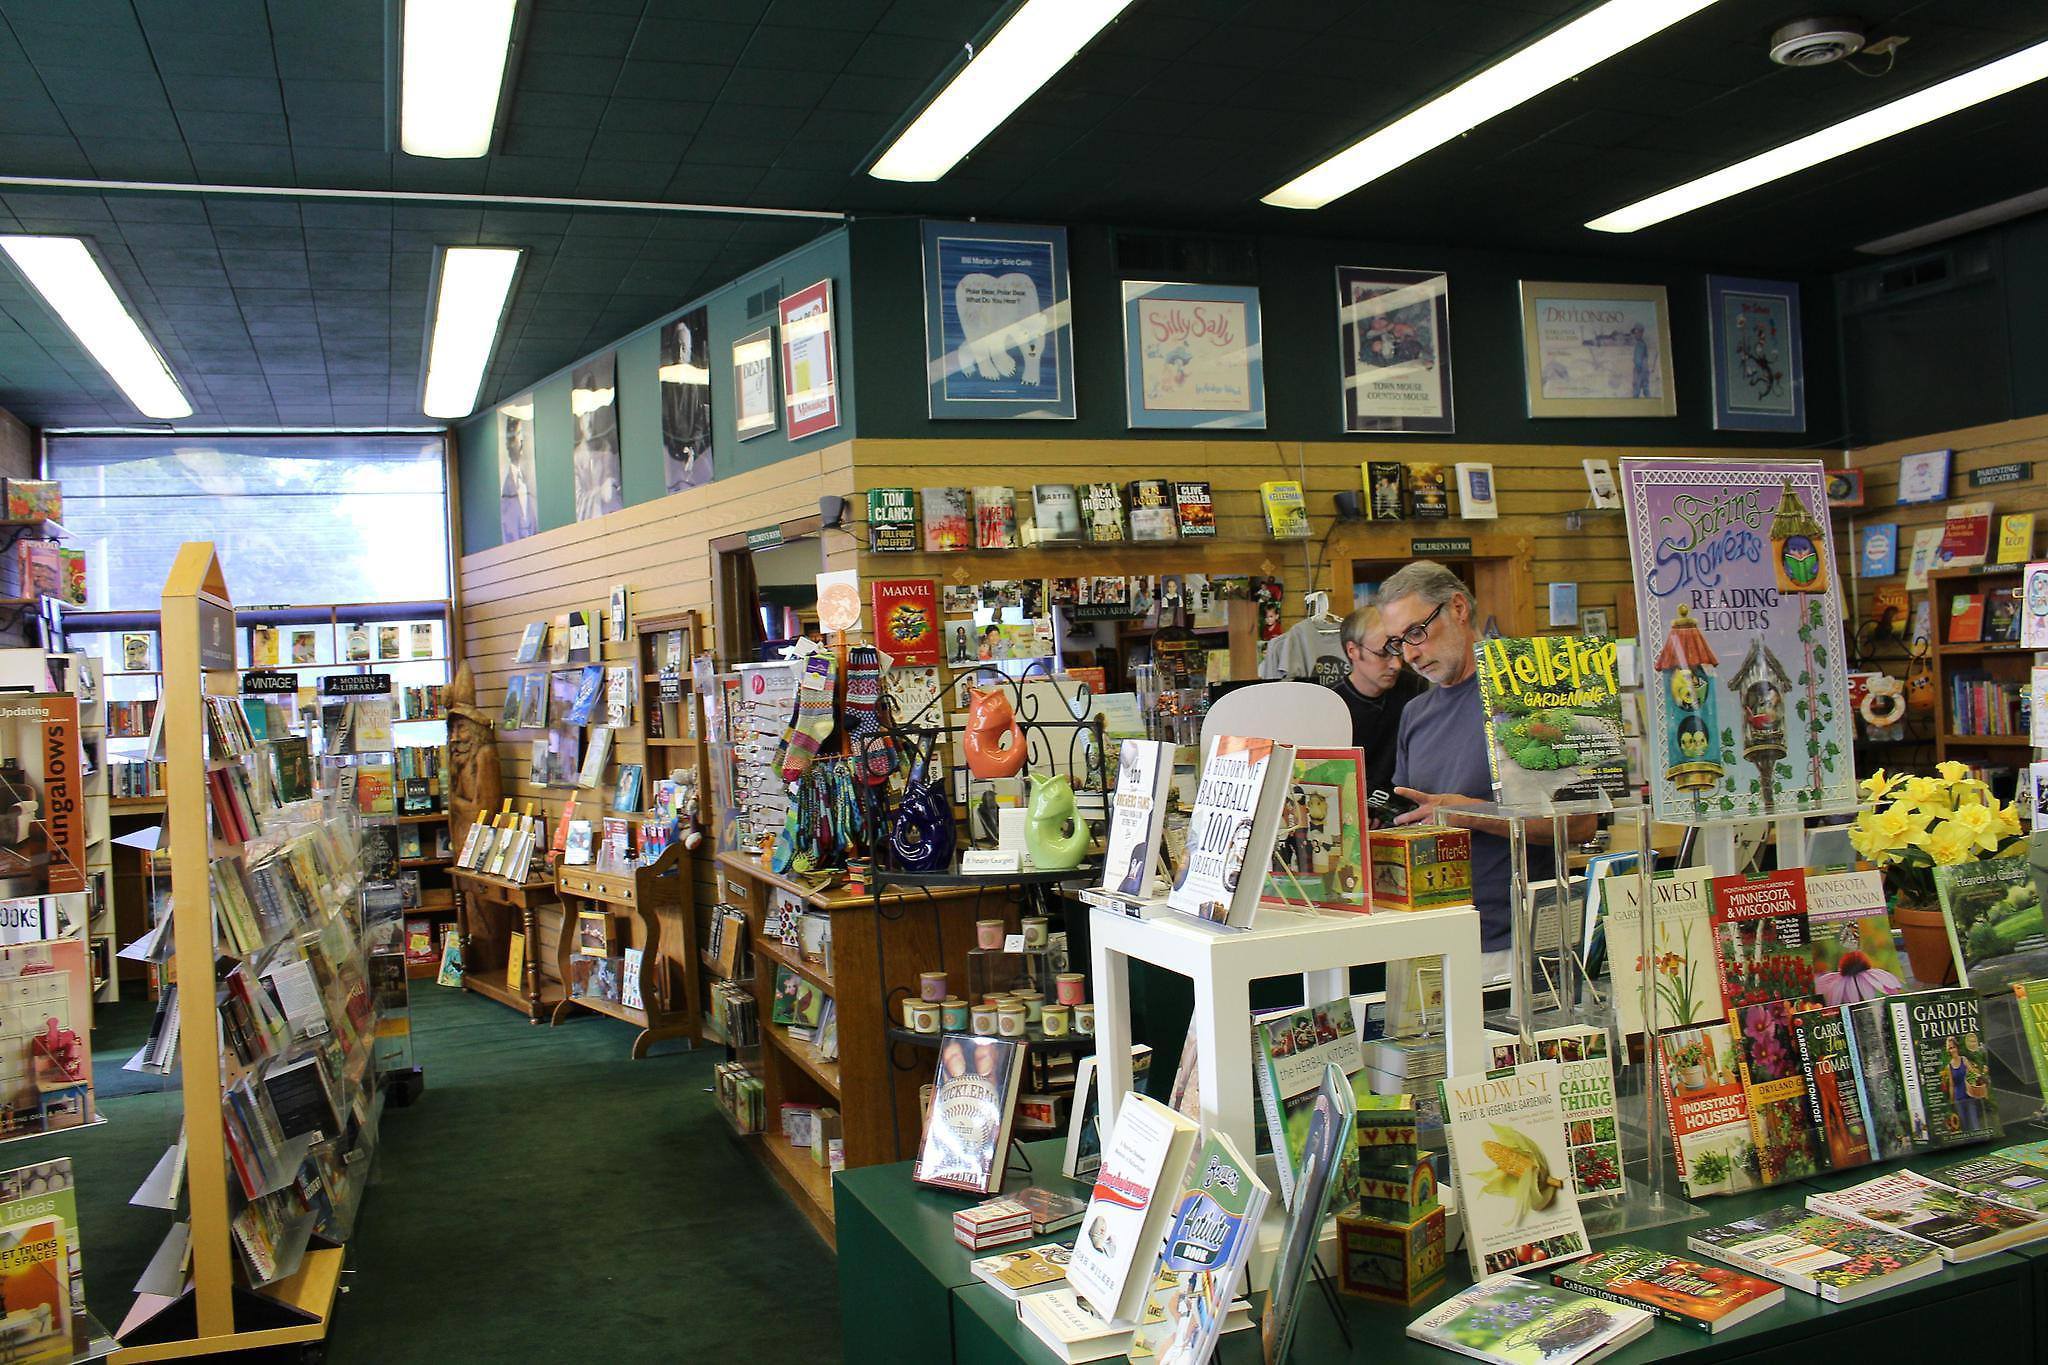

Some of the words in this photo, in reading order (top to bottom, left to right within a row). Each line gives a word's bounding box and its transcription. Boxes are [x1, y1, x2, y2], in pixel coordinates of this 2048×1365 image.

[1545, 306, 1624, 324] DRYLONGSO
[1149, 309, 1191, 342] Silly
[1192, 307, 1234, 347] Sally
[1374, 382, 1396, 391] TOWN
[1397, 383, 1423, 391] MOUSE
[1368, 392, 1402, 400] COUNTRY
[1404, 392, 1429, 401] MOUSE
[1979, 474, 2020, 486] EDUCATION
[882, 492, 905, 507] TOM
[1088, 488, 1112, 499] JACK
[1176, 494, 1210, 505] CUSSLER
[1181, 486, 1203, 496] CLIVE
[1082, 496, 1123, 511] HIGGINS
[874, 507, 914, 521] CLANCY
[1660, 488, 1775, 552] Spring
[1413, 542, 1450, 551] CHILDREN'S
[1451, 542, 1471, 550] ROOM
[1648, 530, 1762, 597] Showers
[882, 585, 931, 597] MARVEL
[1691, 588, 1779, 610] READING
[1879, 593, 1904, 605] Sun
[1077, 608, 1107, 617] RECENT
[1704, 610, 1770, 632] HOURS
[1484, 635, 1618, 696] Hellstrip
[252, 678, 293, 689] VINTAGE
[1524, 687, 1607, 707] GARDENING
[1206, 758, 1213, 776] A
[1214, 758, 1247, 780] HISTORY
[1248, 762, 1263, 781] OF
[45, 725, 73, 866] Bungalows
[1116, 794, 1137, 808] BREWERS
[1138, 795, 1151, 810] FANS
[1198, 780, 1253, 812] BASEBALL
[1204, 812, 1233, 855] 100
[1191, 854, 1224, 879] OBJECTS
[1957, 875, 1986, 888] Heaven
[1997, 870, 2026, 882] Garden
[1730, 889, 1791, 906] MINNESOTA
[1816, 891, 1880, 909] WISCONSIN
[1727, 908, 1736, 919] &
[1736, 900, 1797, 916] WISCONSIN
[1913, 1000, 1979, 1022] GARDEN
[1920, 1018, 1980, 1039] PRIMER
[1796, 1028, 1809, 1064] CARROTS
[1280, 1066, 1294, 1081] the
[1295, 1056, 1326, 1073] HERBAL
[1326, 1042, 1359, 1066] KITCHEN
[1562, 1061, 1609, 1081] GROW
[1804, 1064, 1813, 1082] LOVE
[1456, 1070, 1552, 1109] MIDWEST
[1560, 1076, 1610, 1095] CALLY
[1759, 1080, 1793, 1095] DRYLAND
[1460, 1106, 1477, 1122] FRUIT
[1480, 1108, 1486, 1118] &
[1488, 1100, 1519, 1118] VEGETABLE
[1518, 1094, 1552, 1111] GARDENING
[1658, 1048, 1674, 1118] INDESTRUCTIBLE
[1669, 1118, 1685, 1174] HOUSEPLANT
[1808, 1082, 1823, 1123] TOMATOES
[1266, 1093, 1281, 1136] KITCHEN
[1685, 1111, 1745, 1129] HOUSEPL
[1825, 1175, 1913, 1203] CONTAINER
[1839, 1181, 1931, 1208] GARDENING
[8, 1200, 56, 1221] Ideas
[1178, 1193, 1231, 1244] Activity
[15, 1248, 58, 1266] SPACES
[18, 1239, 57, 1256] TRICKS
[1182, 1245, 1209, 1263] BOOK
[1752, 1239, 1807, 1258] MIDWEST
[1578, 1250, 1641, 1277] CARROTS
[1728, 1254, 1764, 1273] MIDWEST
[1606, 1258, 1681, 1289] TOMATOES
[1564, 1280, 1597, 1297] CARROTS
[1598, 1290, 1619, 1304] LOVE
[1620, 1296, 1661, 1316] TOMATOES
